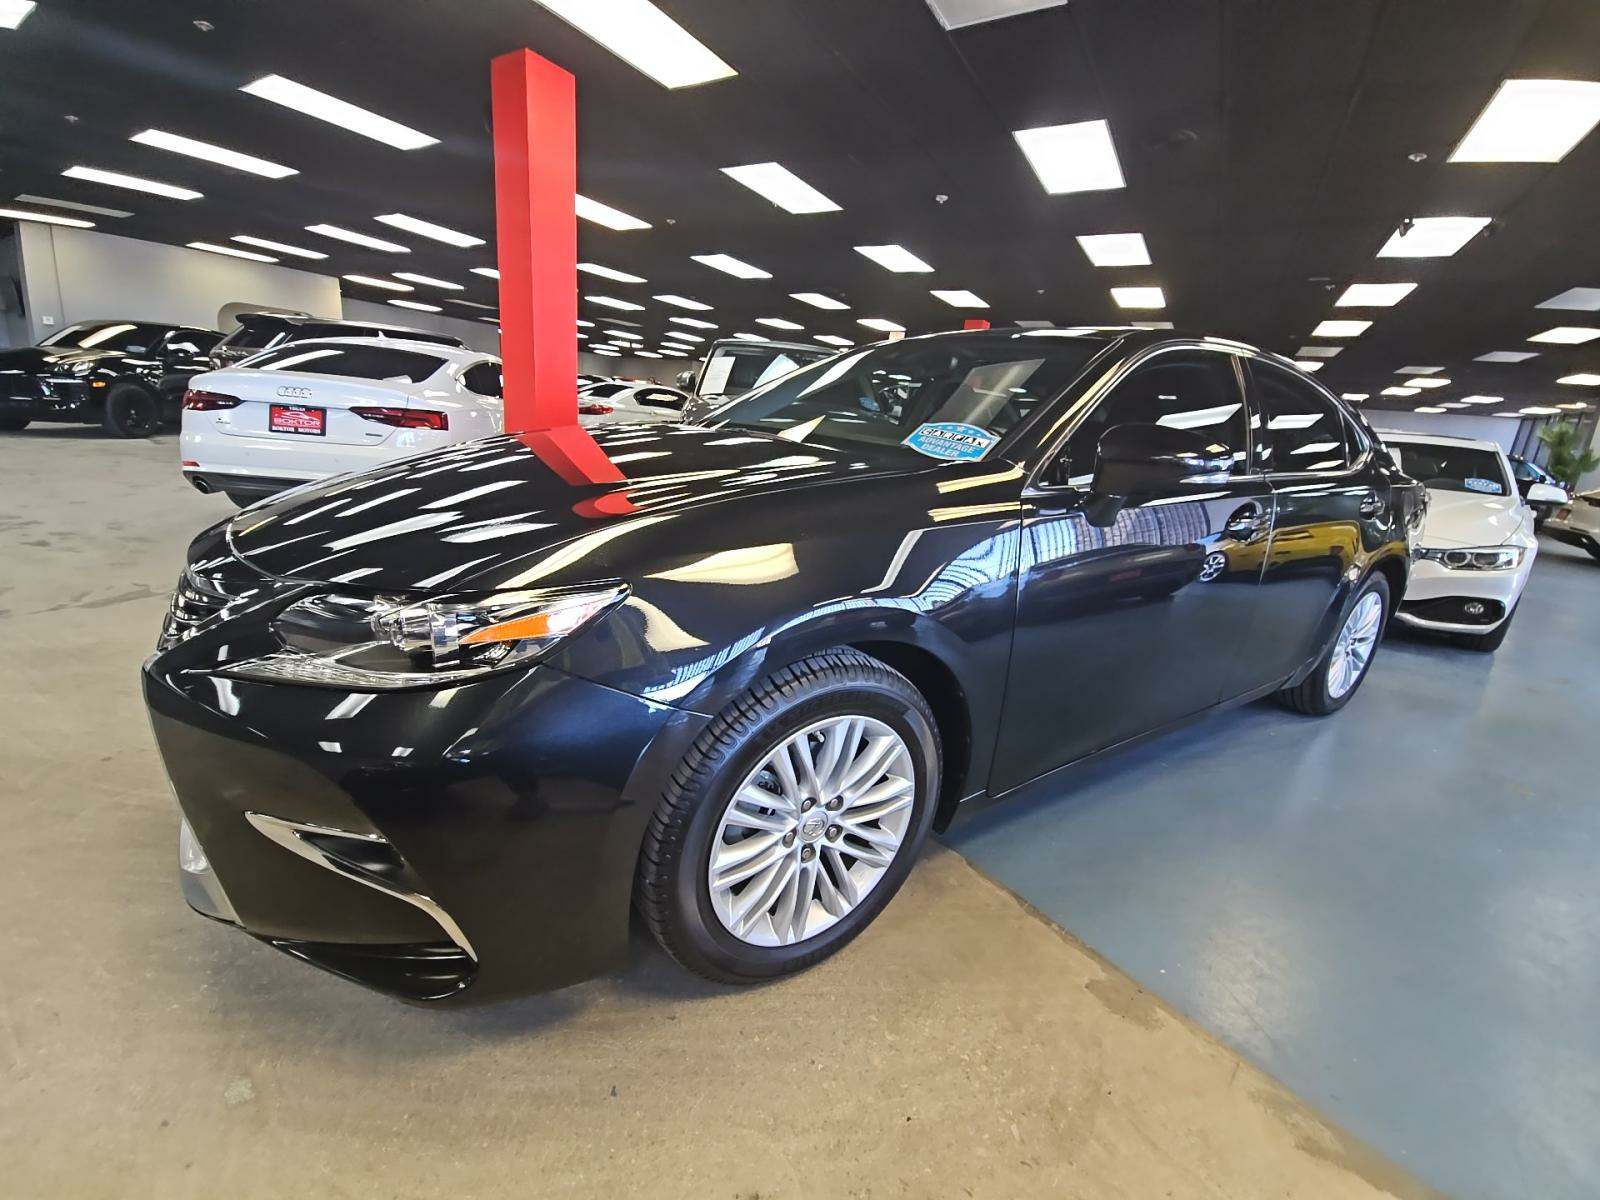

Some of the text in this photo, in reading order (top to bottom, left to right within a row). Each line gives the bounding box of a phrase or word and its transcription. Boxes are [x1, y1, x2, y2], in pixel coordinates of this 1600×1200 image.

[273, 417, 321, 428] BOKTOR
[920, 436, 975, 454] ADVANTAGE
[921, 427, 989, 448] CARFAX
[921, 443, 960, 457] DEALER
